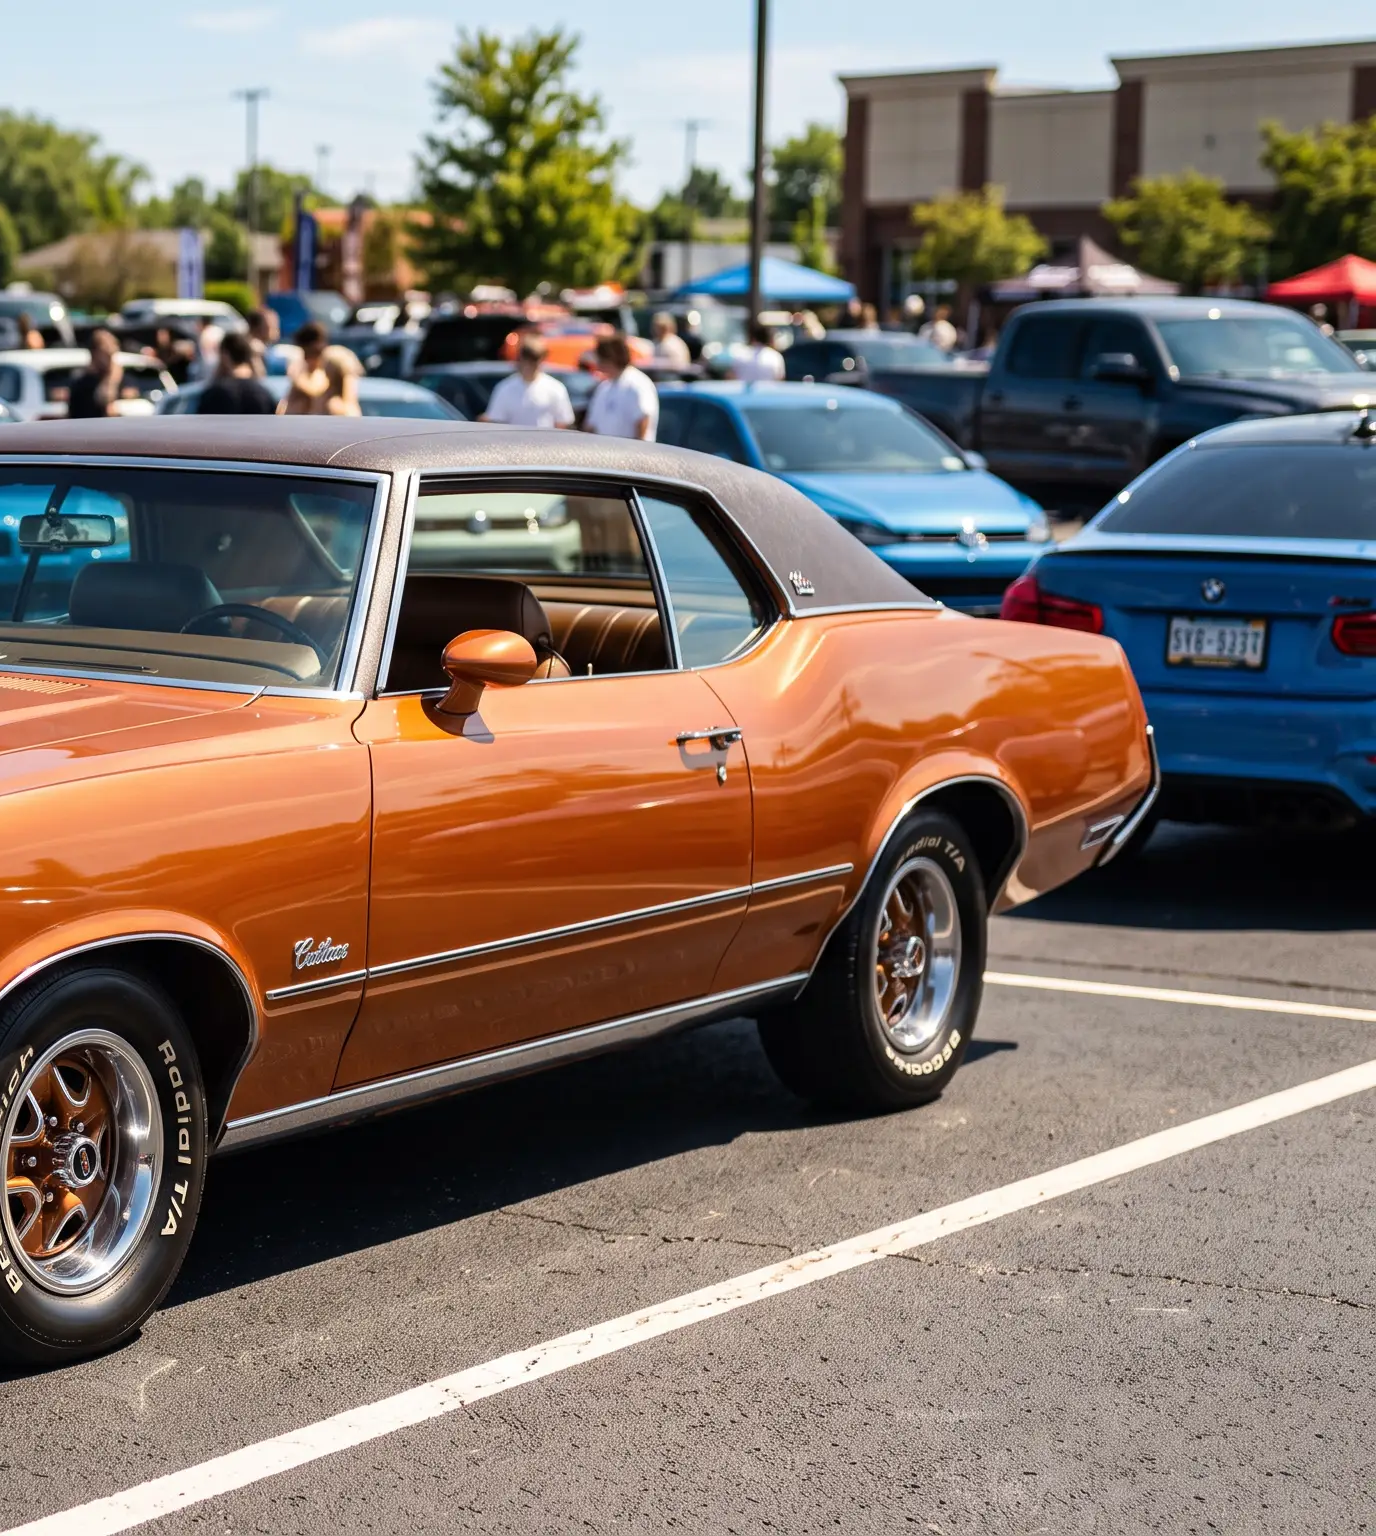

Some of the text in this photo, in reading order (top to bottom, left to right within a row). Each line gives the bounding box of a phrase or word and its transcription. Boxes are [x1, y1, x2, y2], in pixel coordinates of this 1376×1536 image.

[294, 937, 349, 970] Cutlass
[158, 1039, 192, 1236] Radial T/A
